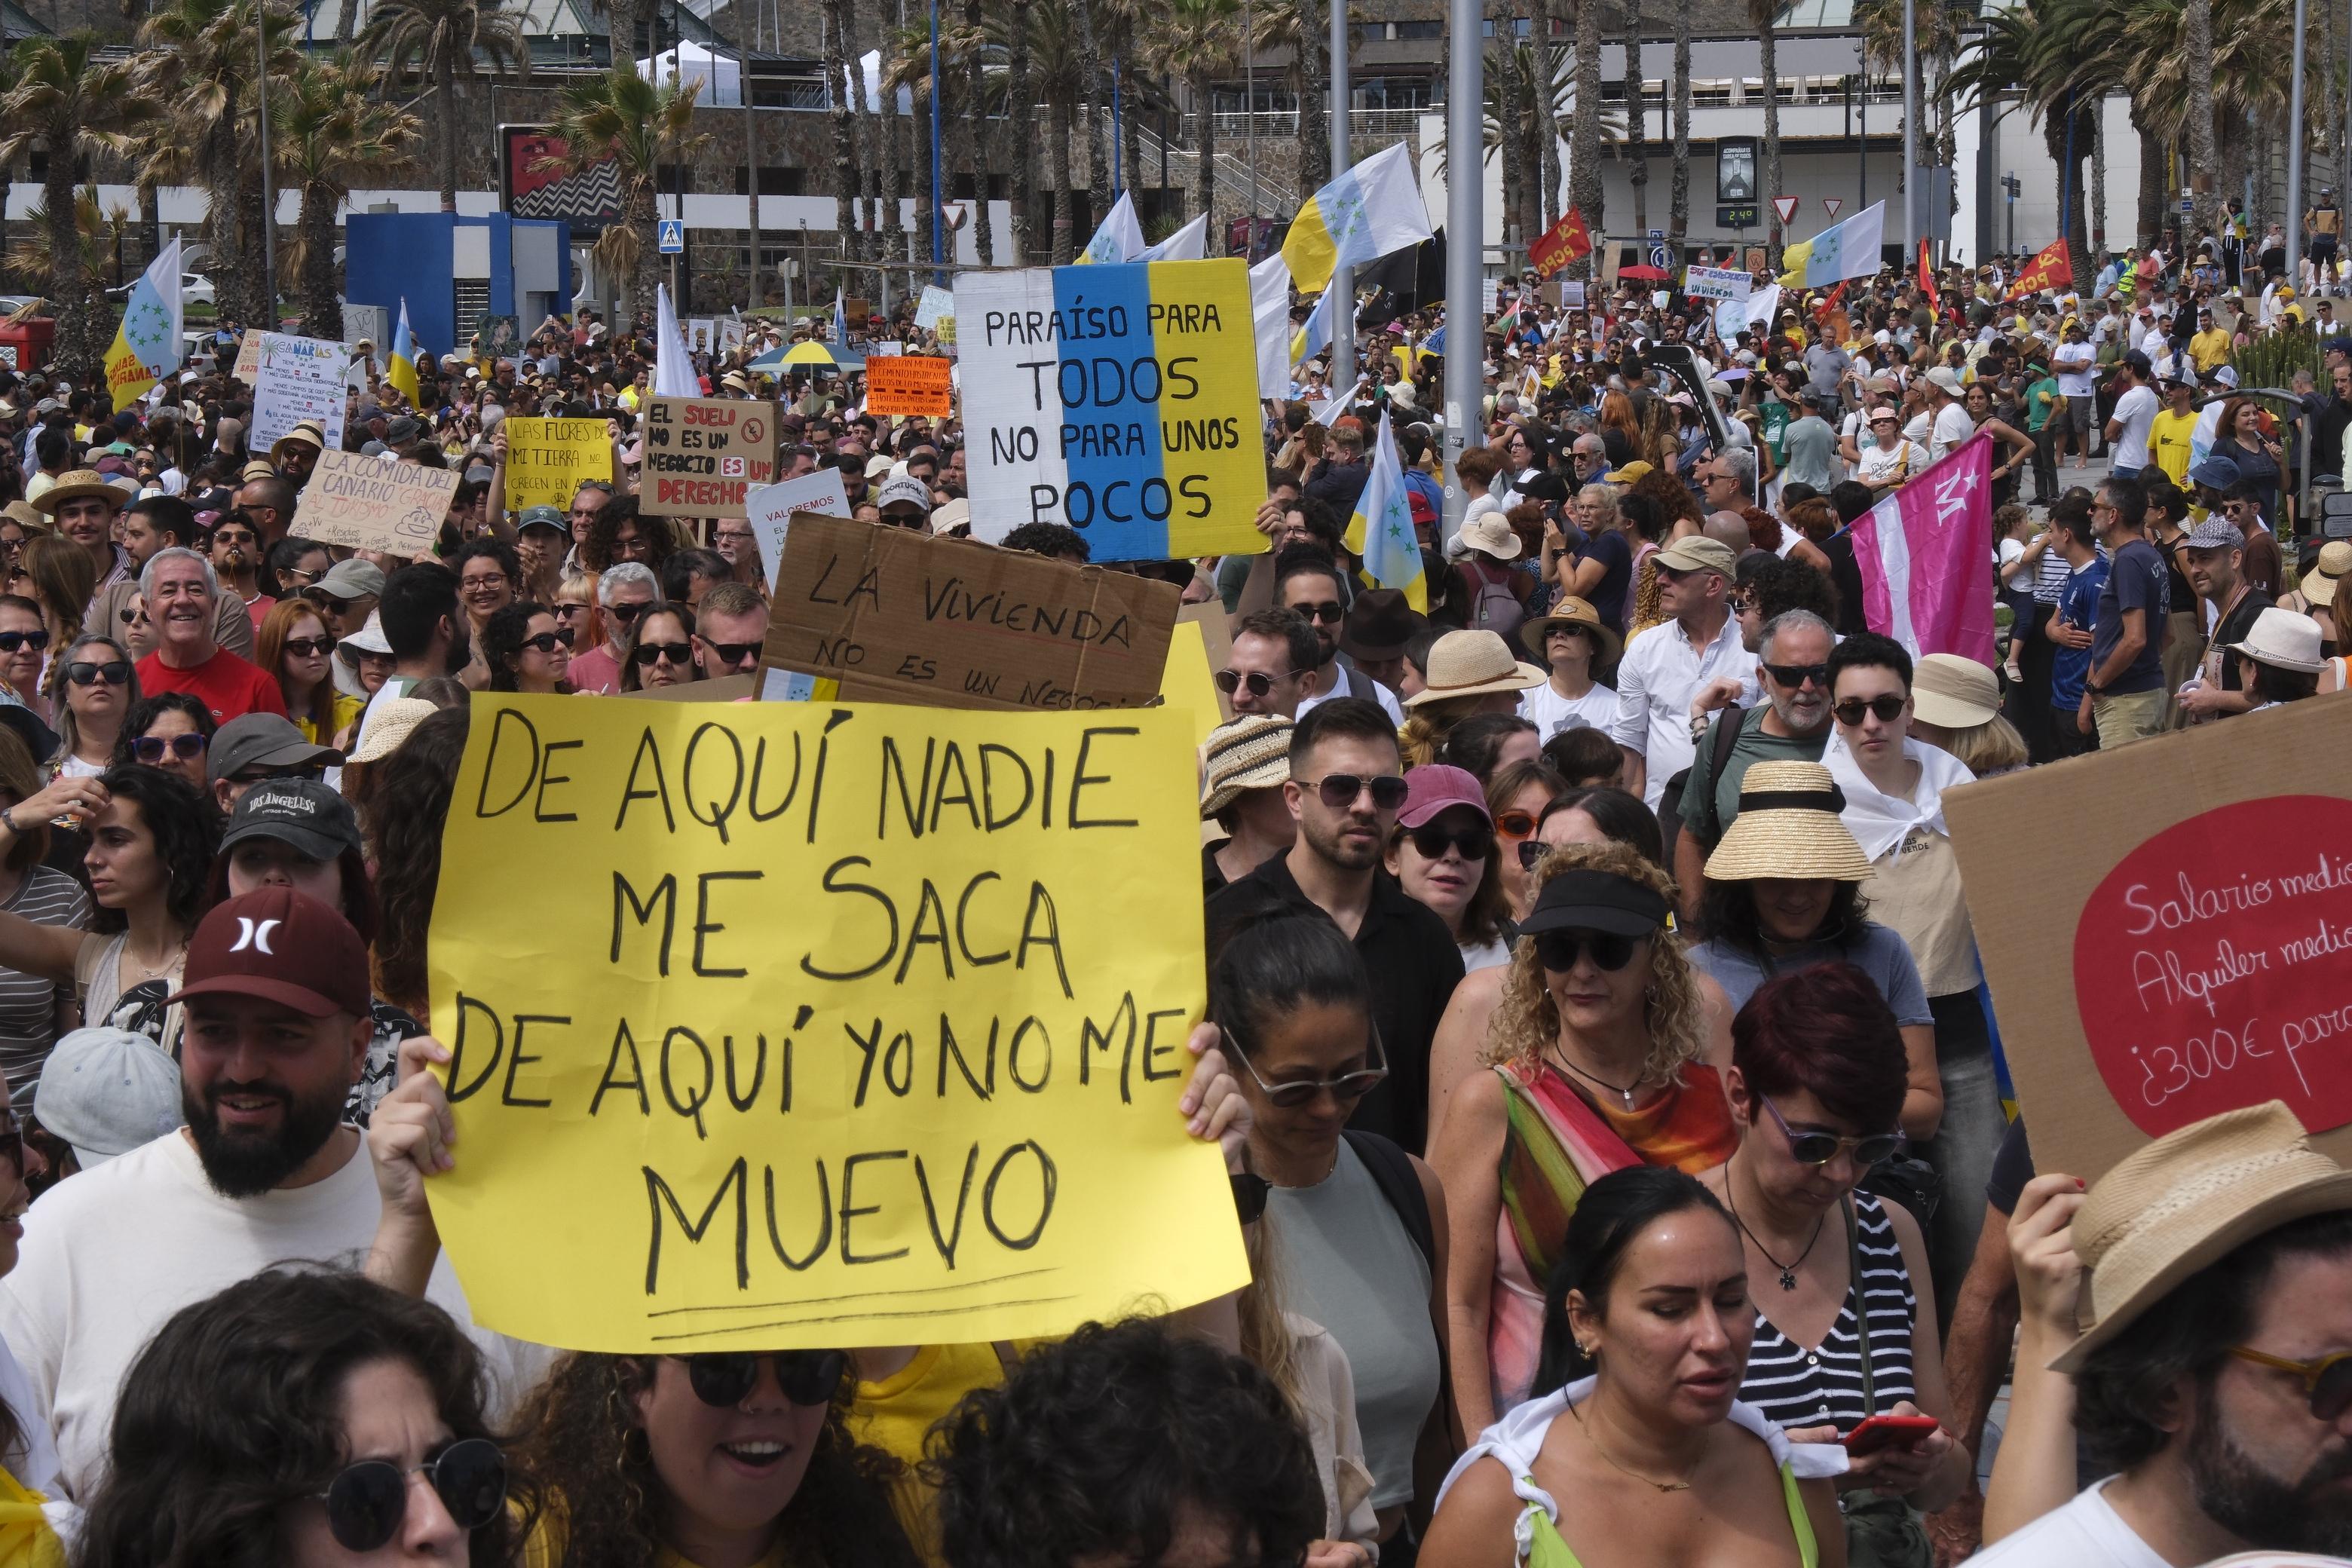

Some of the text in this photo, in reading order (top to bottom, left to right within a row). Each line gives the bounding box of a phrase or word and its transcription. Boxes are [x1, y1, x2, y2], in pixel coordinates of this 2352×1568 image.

[986, 295, 1129, 347] PARAÍSO
[1147, 304, 1222, 336] PARA
[868, 359, 886, 368] NOS
[878, 369, 910, 378] CEMENTO
[1015, 357, 1199, 412] TODOS
[650, 403, 736, 427] EL SUELO
[514, 422, 605, 441] LAS FLORES DE
[648, 427, 728, 449] NO ES UN
[991, 417, 1239, 466] NO PARA UNOS
[323, 453, 452, 490] LA COMIDA DEL
[513, 448, 601, 467] MI TIERRA NO
[648, 453, 772, 481] NEGOCIO ES UN
[323, 473, 395, 501] CANARIO
[511, 476, 549, 490] CRECEN
[556, 478, 568, 489] EN
[657, 478, 747, 505] DERECHO
[884, 482, 923, 498] PORTUGAL
[307, 494, 324, 510] AL
[1030, 474, 1212, 529] POCOS
[809, 553, 879, 613] LA
[813, 638, 865, 666] NO
[896, 654, 937, 680] ES
[964, 669, 1001, 696] UN
[476, 707, 1141, 846] DE AQUÍ NADIE
[248, 795, 265, 813] LOS
[2124, 871, 2272, 936] Salario
[609, 855, 1074, 1000] ME SACA
[2133, 939, 2271, 1018] Alquiler
[445, 990, 571, 1107] DE
[588, 1004, 815, 1141] AQUÍ
[937, 1012, 1052, 1101] NO
[1080, 989, 1187, 1105] ME
[642, 1138, 1058, 1296] MUEVO
